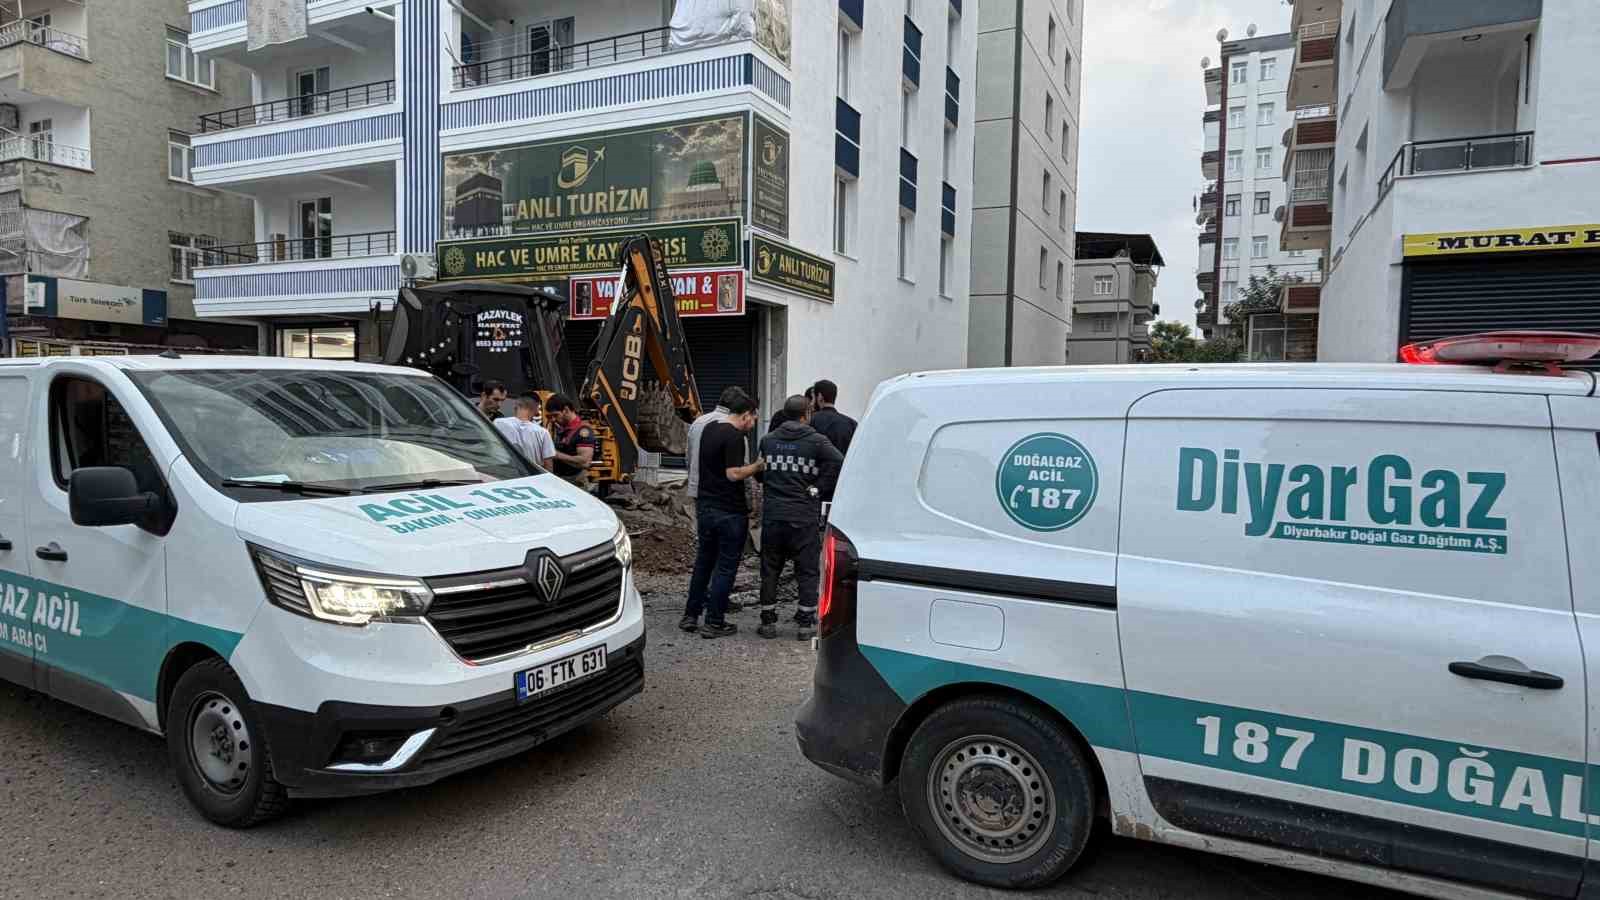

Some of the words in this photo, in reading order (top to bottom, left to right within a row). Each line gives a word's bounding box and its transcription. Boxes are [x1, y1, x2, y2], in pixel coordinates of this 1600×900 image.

[516, 196, 561, 220] ANLI
[567, 186, 649, 215] TURİZM
[1437, 231, 1576, 250] MURAT
[475, 250, 506, 268] HAC
[511, 248, 530, 266] VE
[535, 245, 580, 265] UMRE
[779, 253, 799, 276] ANLI
[800, 260, 830, 286] TURİZM
[702, 275, 713, 294] &
[477, 309, 523, 324] KAZAYLEK
[621, 335, 641, 400] JCB
[1014, 453, 1082, 469] DOĞALGAZ
[1028, 469, 1065, 482] ACİL
[358, 493, 474, 522] ACİL
[468, 486, 548, 503] 187
[1027, 487, 1081, 510] 187
[1176, 447, 1507, 537] DiyarGaz
[386, 511, 456, 534] BAKIM
[463, 503, 530, 521] ONARIM
[1283, 525, 1346, 541] Diyarbakır
[1351, 528, 1387, 544] Doğal
[1390, 532, 1415, 545] Gaz
[1418, 533, 1472, 549] Dağıtım
[1474, 536, 1503, 552] A.Ş.
[32, 592, 82, 637] ACİL
[11, 626, 48, 654] ARACI
[527, 669, 545, 693] 06
[550, 658, 577, 685] FTK
[582, 648, 605, 674] 631
[1196, 714, 1315, 772] 187
[1341, 736, 1600, 825] DOĞAL
